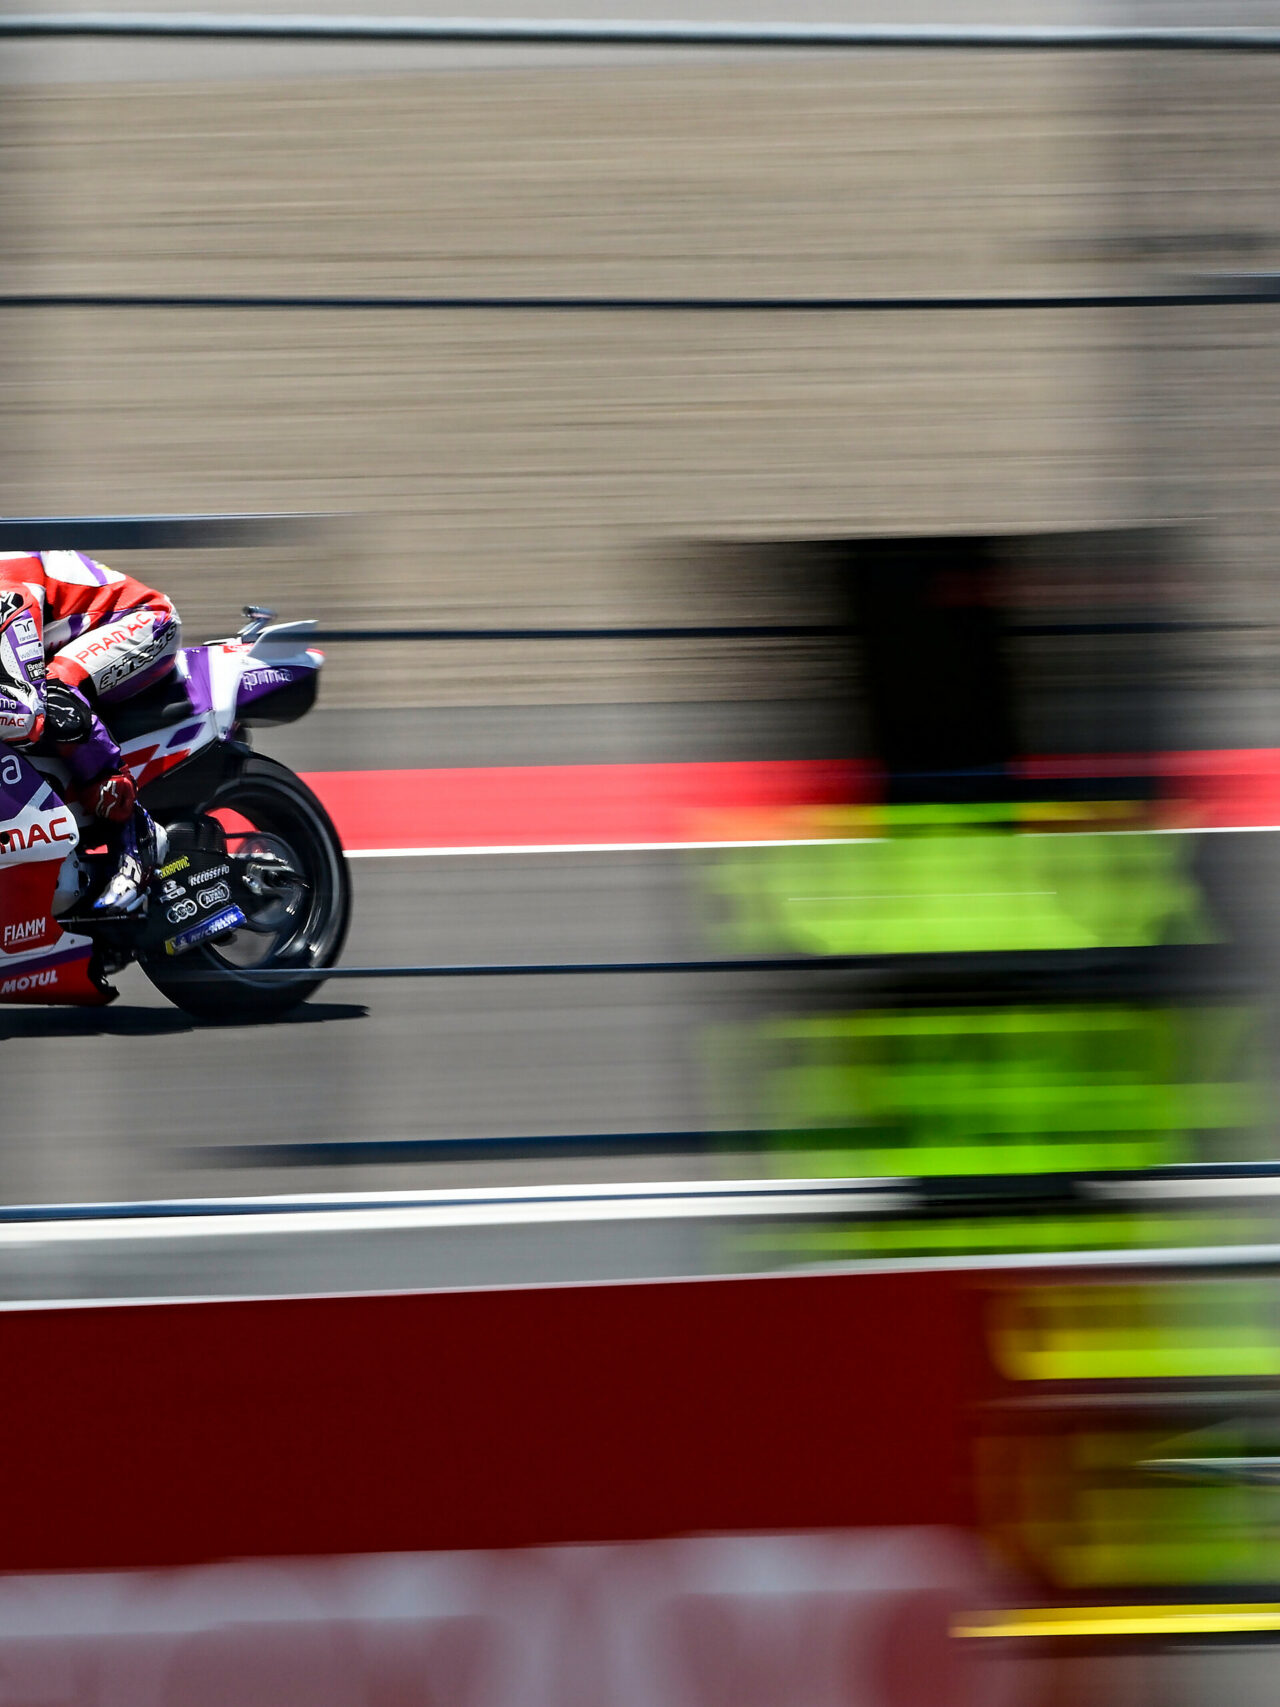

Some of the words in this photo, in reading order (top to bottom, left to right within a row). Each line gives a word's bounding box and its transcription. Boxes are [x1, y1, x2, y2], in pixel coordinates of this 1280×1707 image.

[75, 612, 152, 664] PRAMAC
[4, 917, 46, 942] FIAMM
[0, 970, 58, 994] MOTUL
